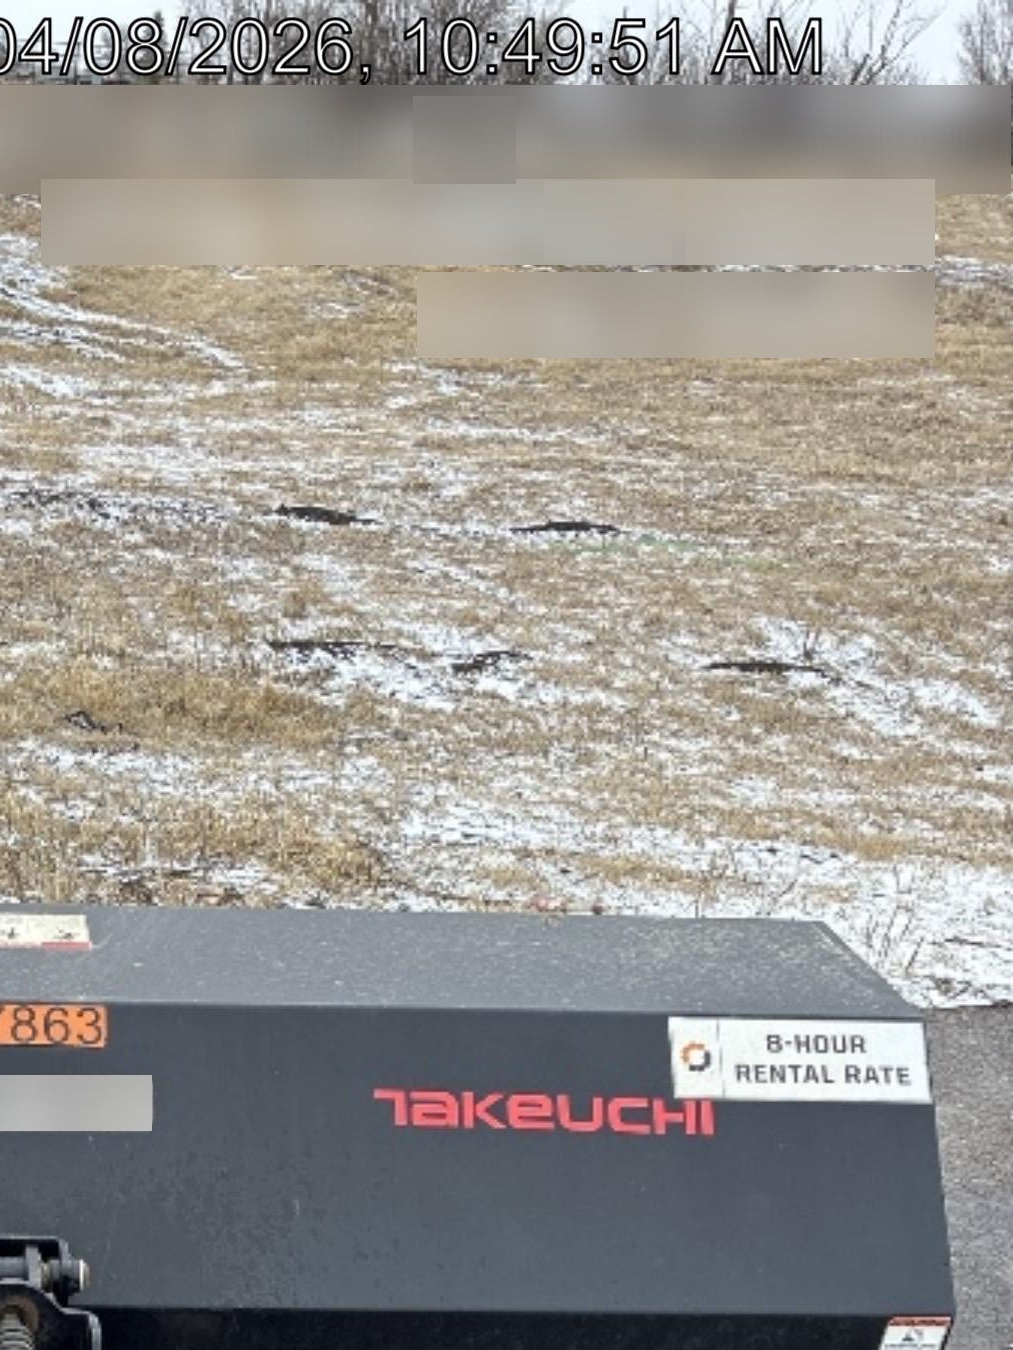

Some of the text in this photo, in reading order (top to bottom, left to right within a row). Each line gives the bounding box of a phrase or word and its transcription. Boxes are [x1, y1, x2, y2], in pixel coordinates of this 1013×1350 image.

[766, 1033, 867, 1055] 8-HOUR
[734, 1063, 912, 1086] RENTAL RATE
[373, 1087, 715, 1136] TAKEUCHI
